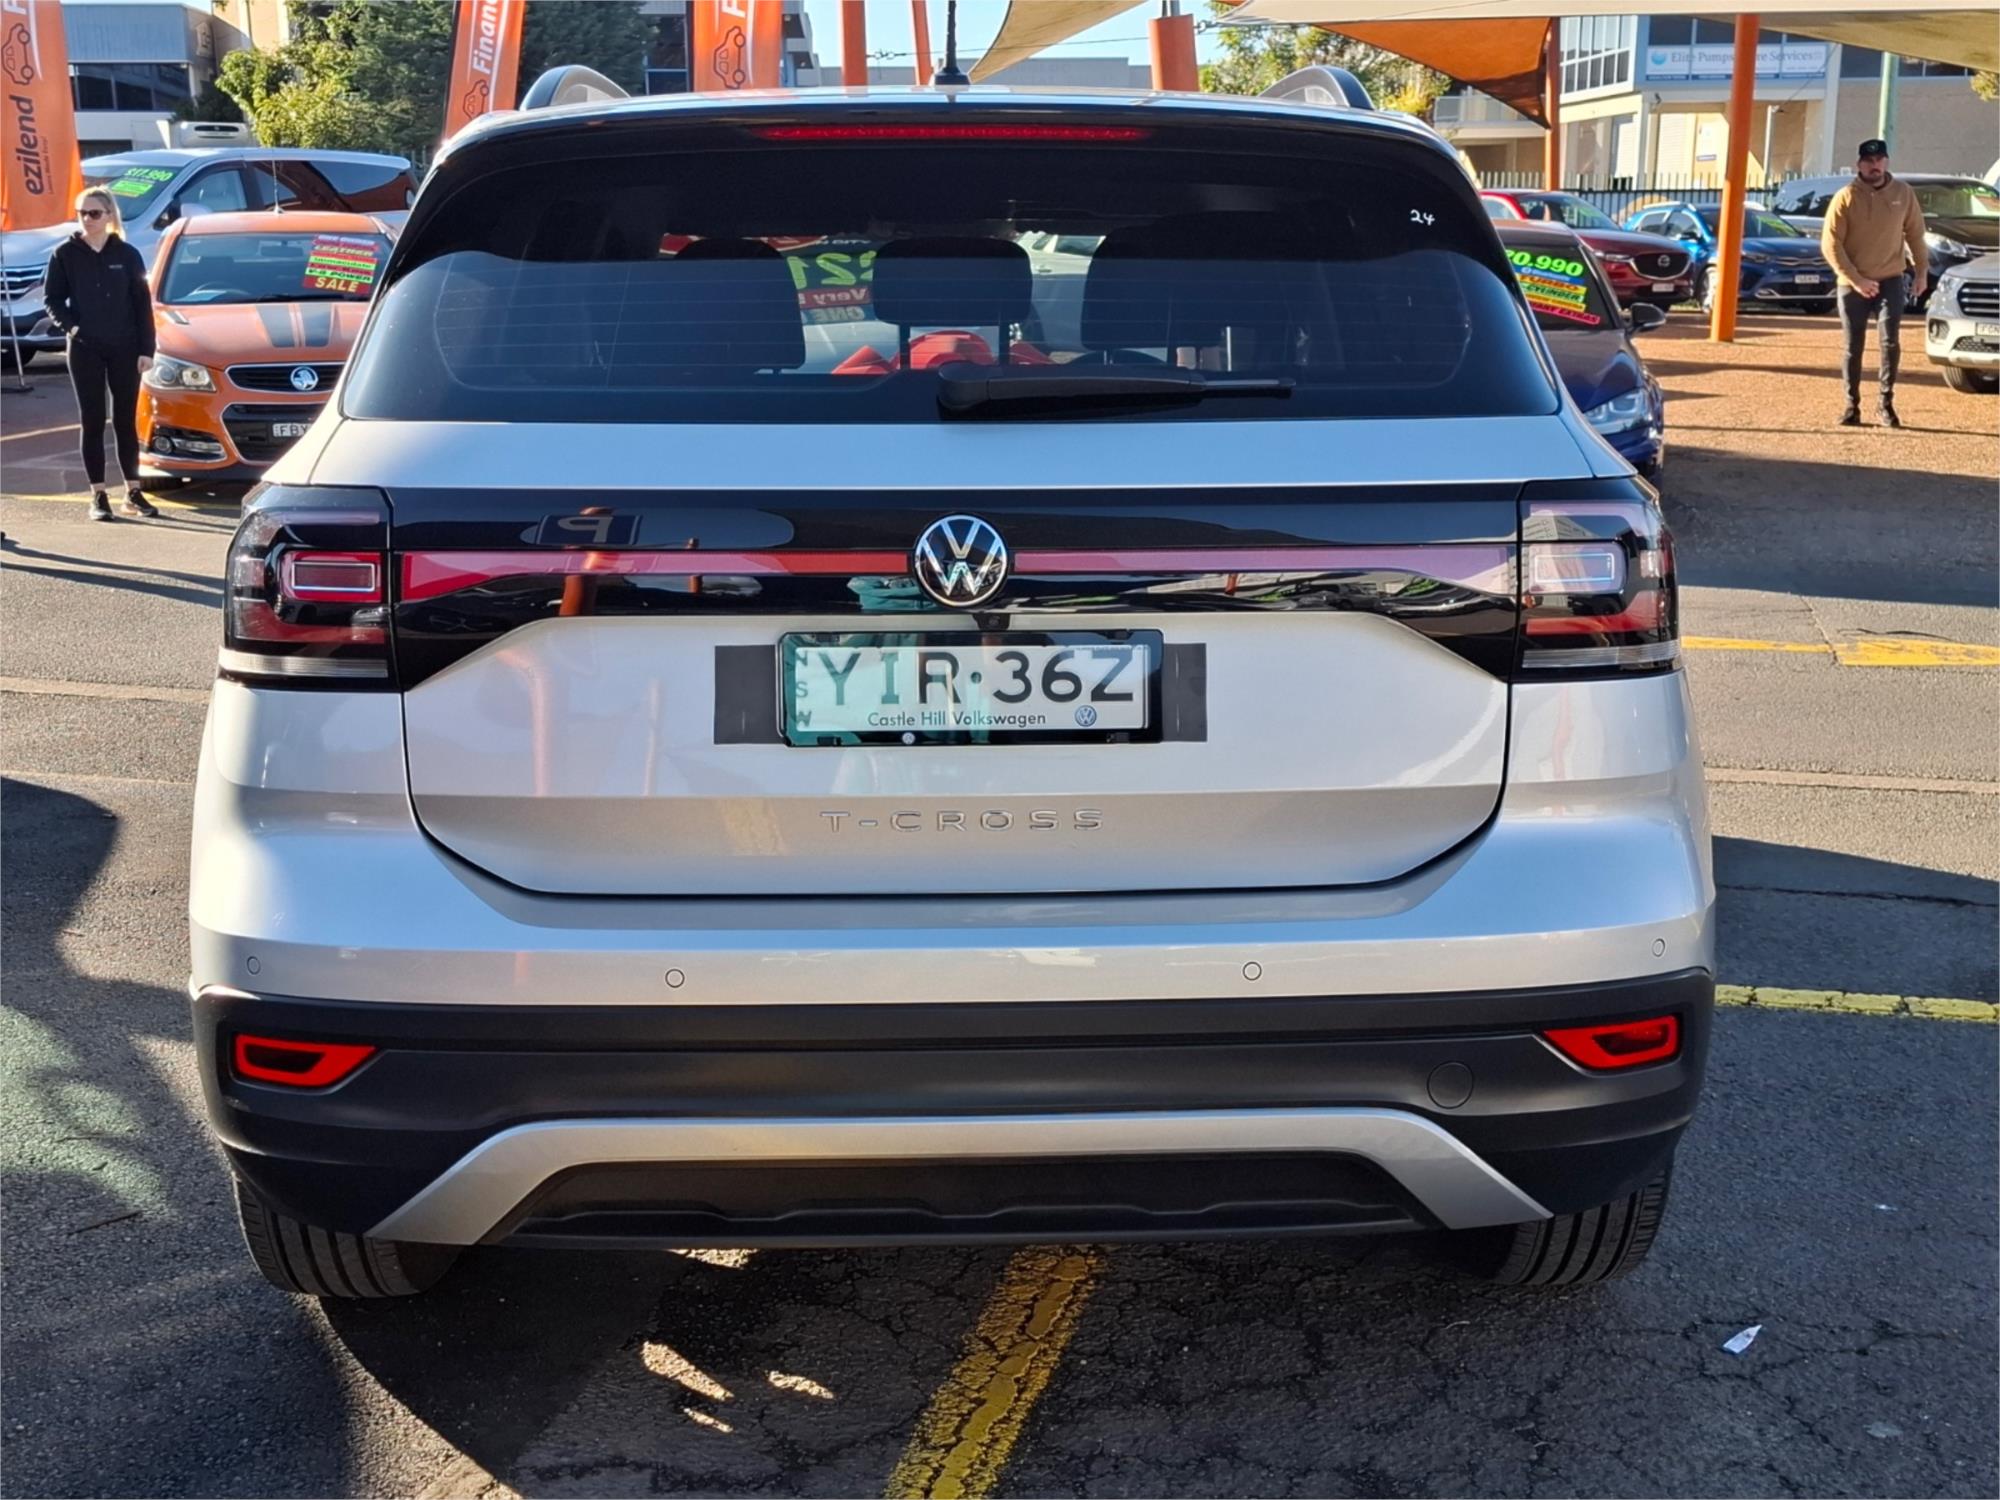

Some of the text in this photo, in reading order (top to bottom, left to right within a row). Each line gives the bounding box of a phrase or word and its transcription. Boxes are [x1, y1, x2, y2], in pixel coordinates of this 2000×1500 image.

[9, 94, 45, 196] ezilend
[1410, 209, 1436, 226] 24
[314, 277, 359, 293] SALE
[867, 711, 916, 727] Castle
[921, 711, 946, 726] Hill
[952, 710, 1046, 728] Volkswagen
[819, 808, 1103, 833] T-CROSS
